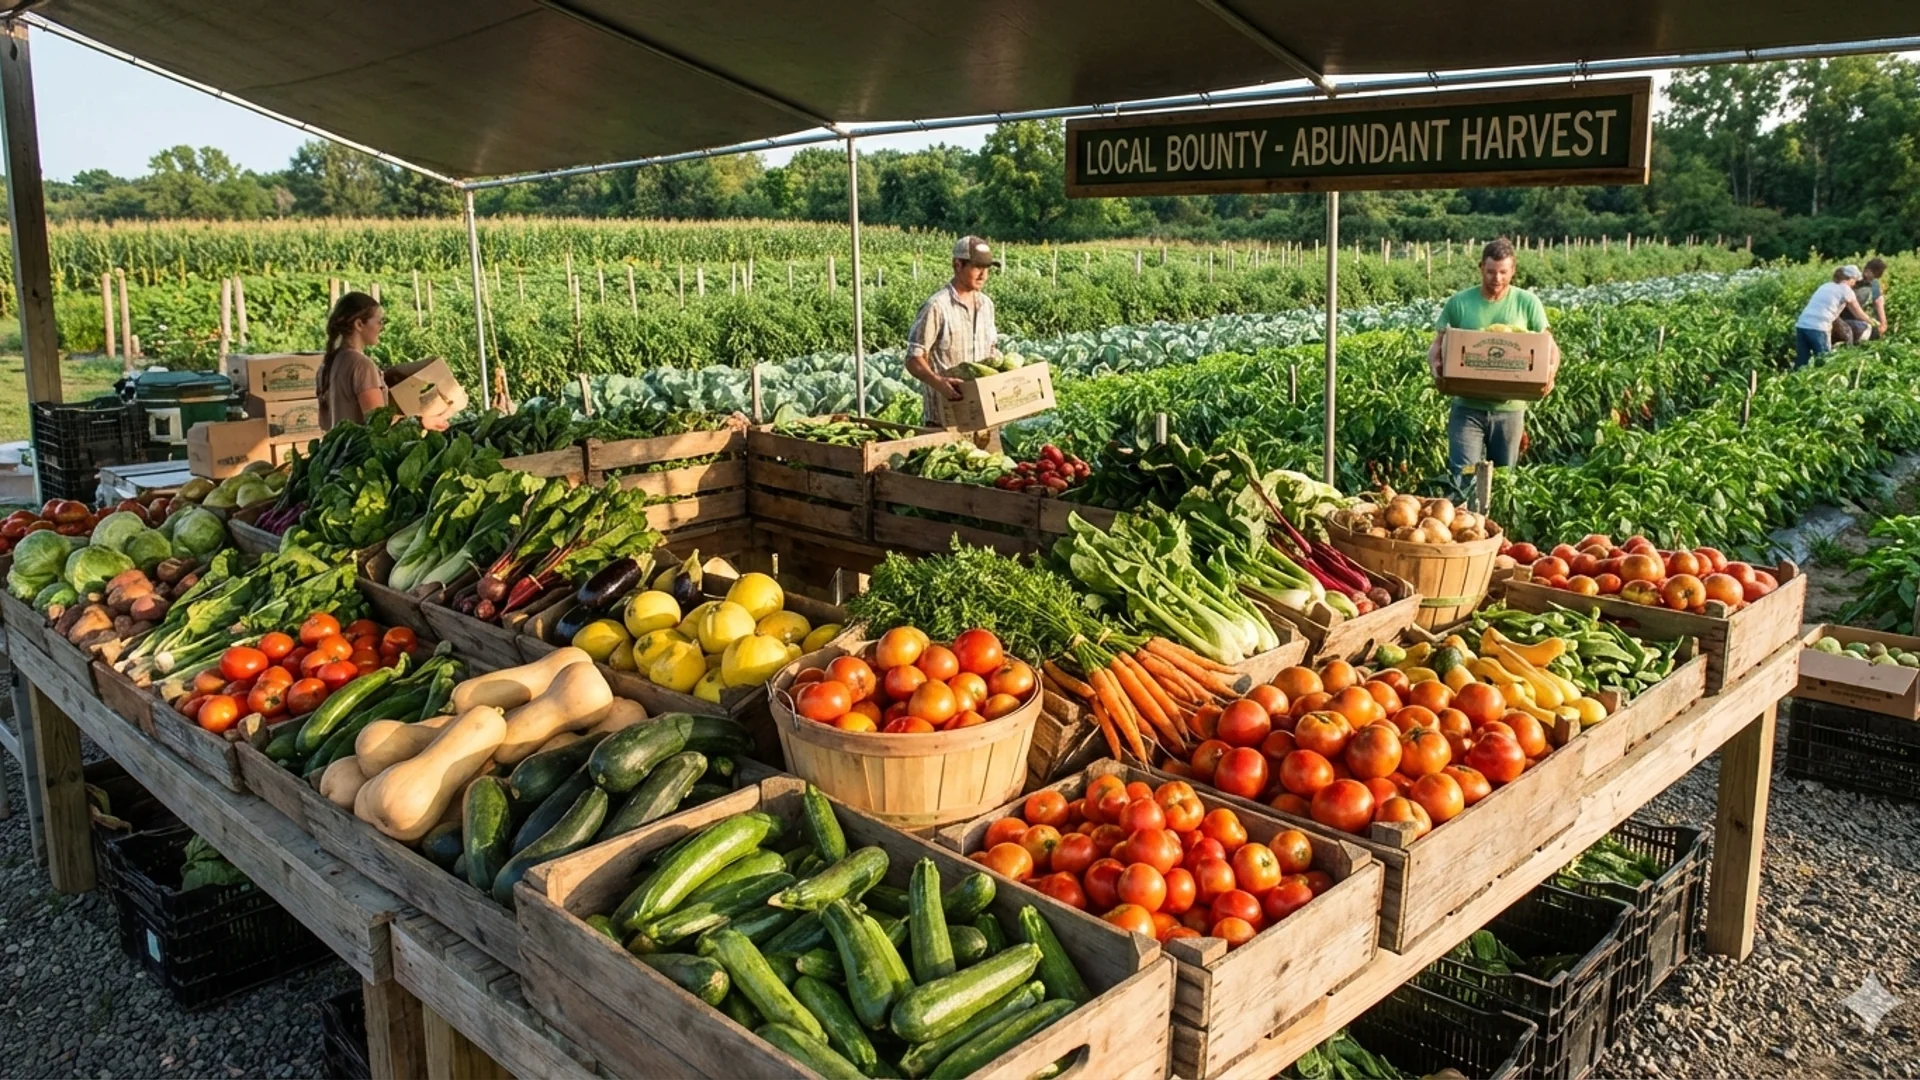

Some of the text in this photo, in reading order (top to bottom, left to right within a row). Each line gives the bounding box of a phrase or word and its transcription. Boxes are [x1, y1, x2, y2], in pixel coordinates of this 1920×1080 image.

[1086, 109, 1617, 175] LOCAL BOUNTY - ABUNDANT HARVEST
